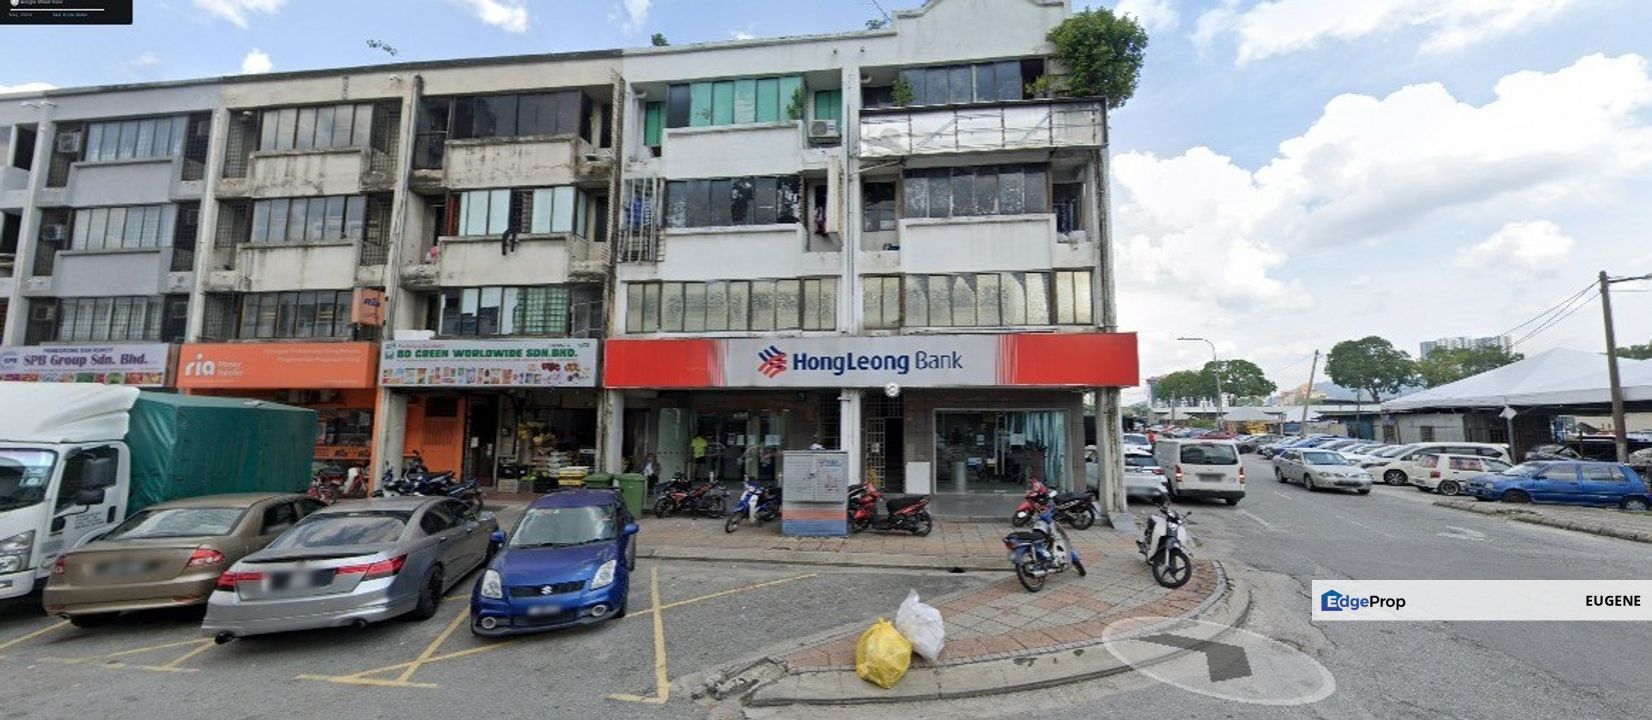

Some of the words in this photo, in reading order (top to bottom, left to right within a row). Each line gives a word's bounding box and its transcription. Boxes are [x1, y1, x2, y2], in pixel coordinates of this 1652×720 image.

[23, 355, 47, 367] SPB
[50, 354, 87, 368] Group
[90, 354, 116, 365] Sdn.
[120, 354, 148, 365] Bhd.
[415, 349, 449, 358] GREEN
[452, 348, 524, 358] WORLDWIDE
[914, 350, 963, 371] Bank
[184, 353, 216, 377] ria
